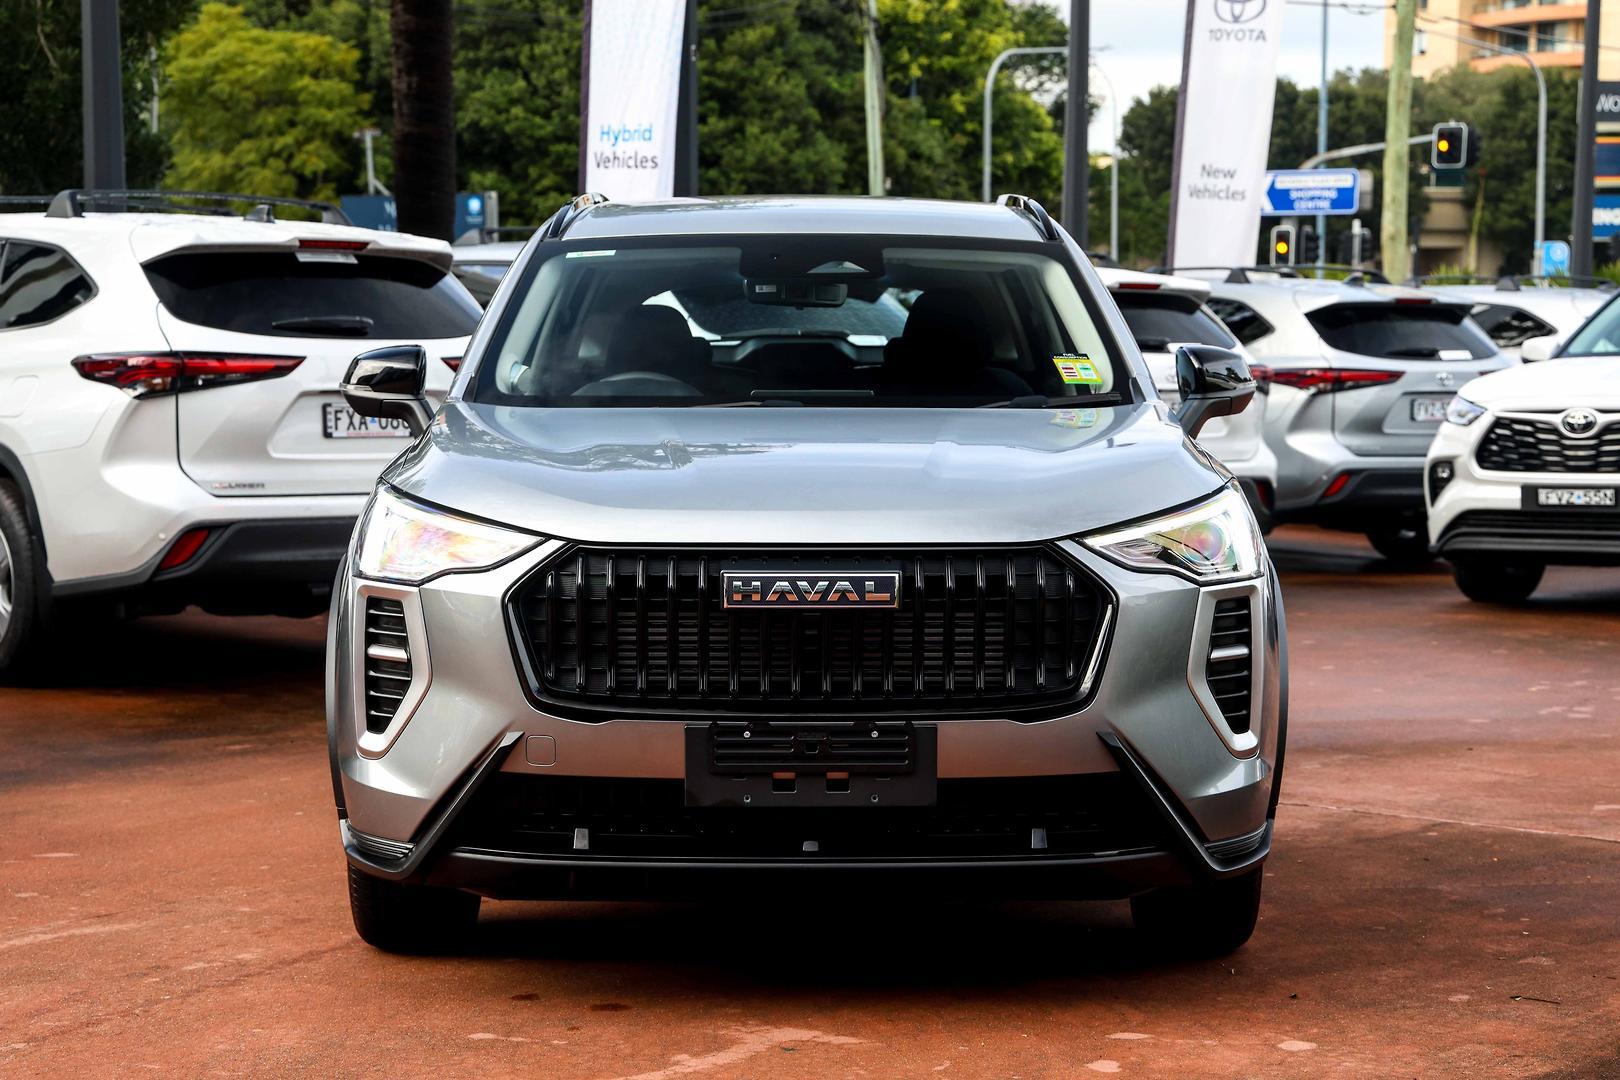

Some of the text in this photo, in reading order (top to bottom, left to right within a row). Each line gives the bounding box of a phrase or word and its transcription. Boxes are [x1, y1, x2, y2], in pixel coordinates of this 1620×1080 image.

[1208, 28, 1267, 42] TOYOTA
[600, 123, 653, 147] Hybrid
[594, 150, 659, 169] Vehicles
[1201, 164, 1237, 179] New
[1187, 183, 1247, 201] Vehicles
[732, 580, 891, 602] HAVAL
